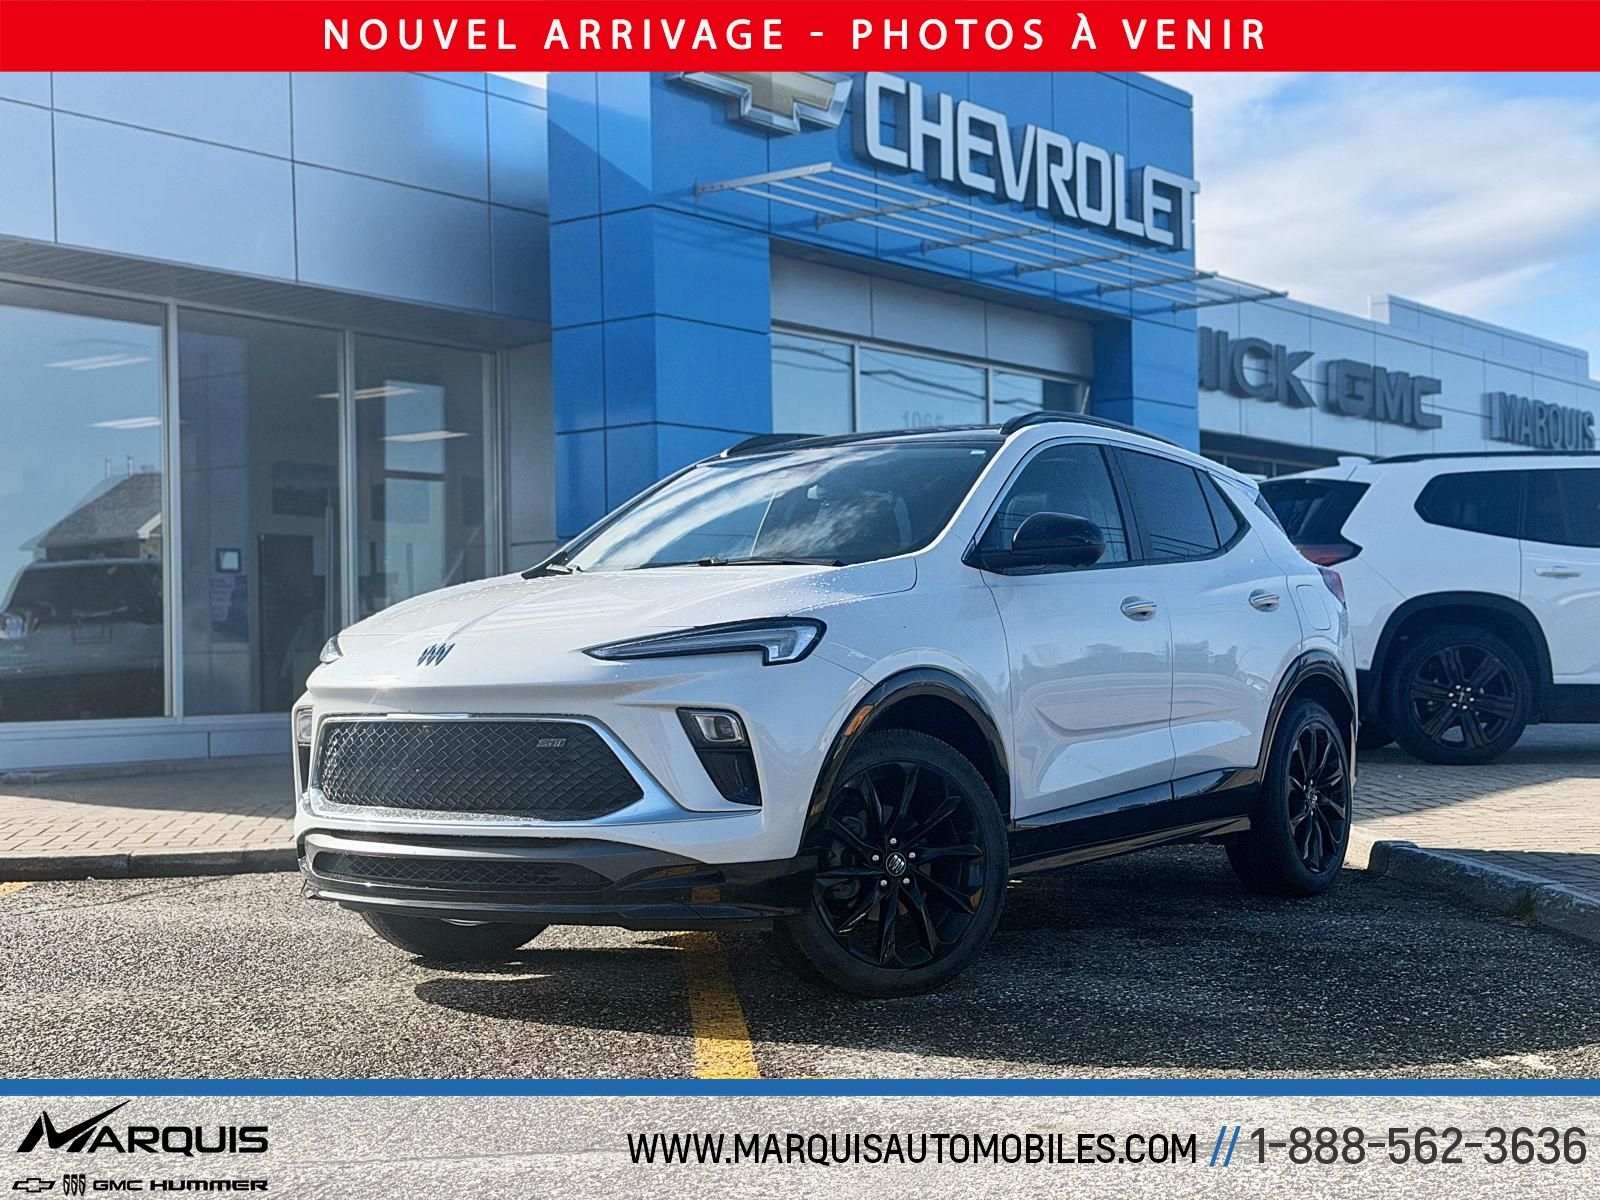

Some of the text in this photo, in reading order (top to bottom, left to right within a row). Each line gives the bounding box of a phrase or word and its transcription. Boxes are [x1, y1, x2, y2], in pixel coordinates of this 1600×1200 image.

[860, 71, 1200, 250] CHEVROLET
[1323, 359, 1442, 430] GMC
[1484, 391, 1595, 450] MARQUIS
